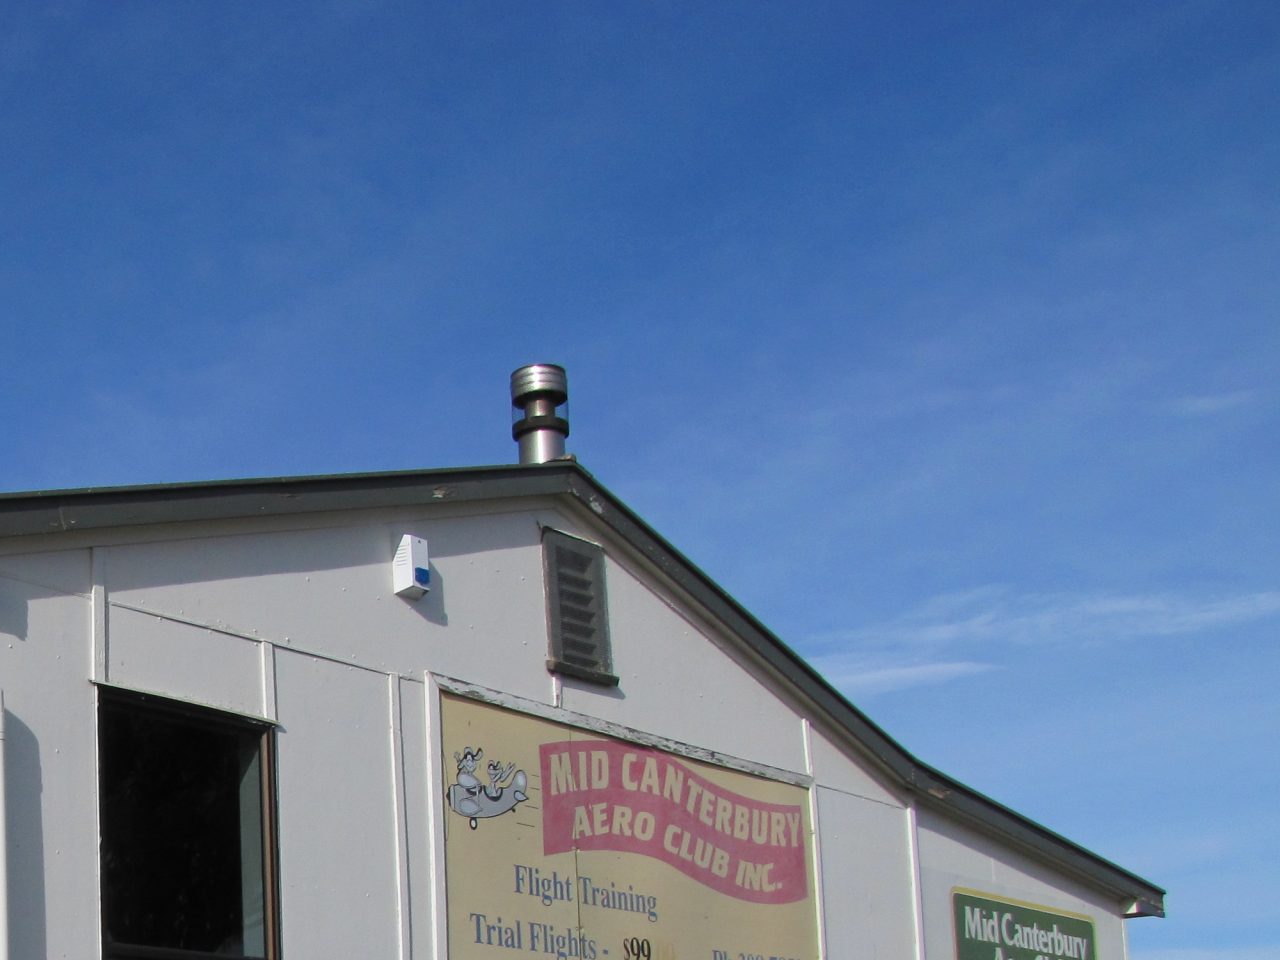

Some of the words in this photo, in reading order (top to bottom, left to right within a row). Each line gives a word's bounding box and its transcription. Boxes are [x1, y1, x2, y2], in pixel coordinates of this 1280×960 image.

[549, 750, 609, 796] MID
[621, 752, 801, 848] CANTERBURY
[572, 802, 656, 842] AERO
[663, 824, 730, 879] CLUB
[735, 859, 784, 894] INC.
[514, 864, 574, 907] Flight
[578, 876, 658, 923] Training
[470, 912, 522, 950] Trial
[964, 905, 1000, 944] Mid
